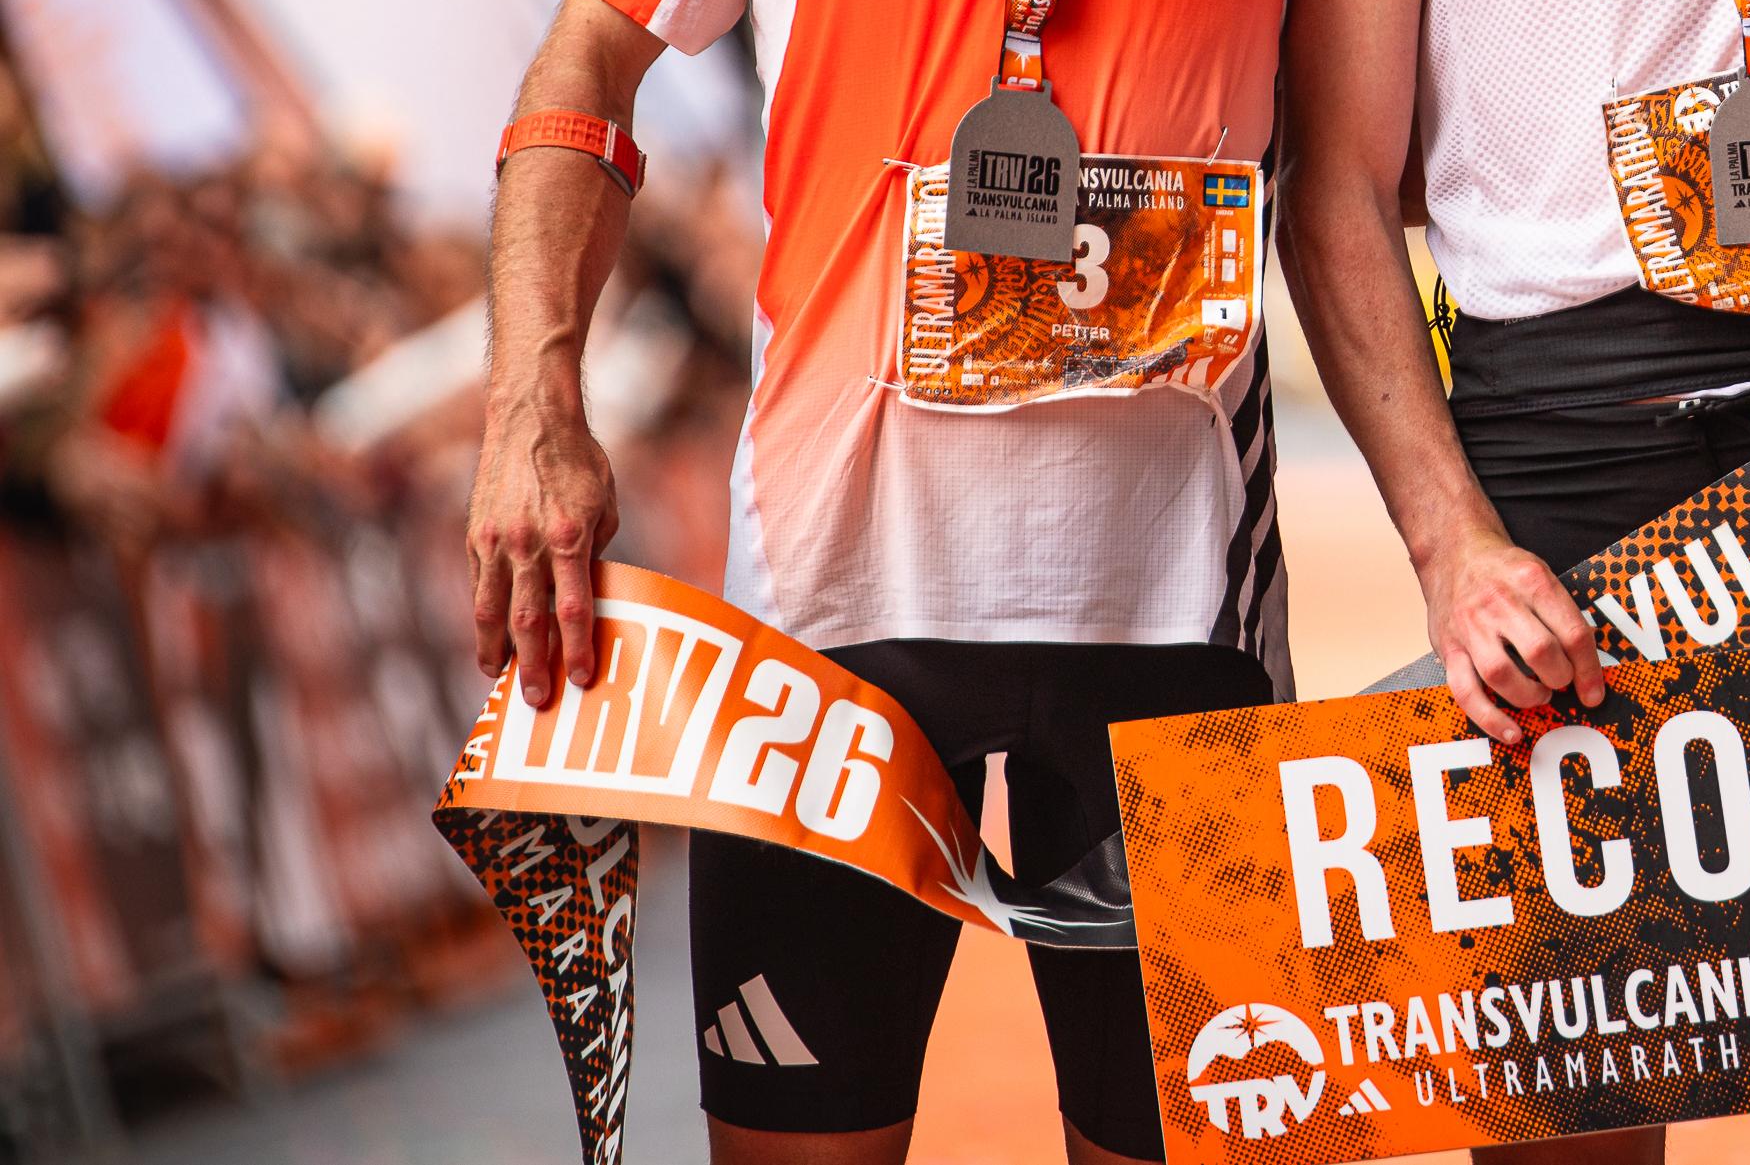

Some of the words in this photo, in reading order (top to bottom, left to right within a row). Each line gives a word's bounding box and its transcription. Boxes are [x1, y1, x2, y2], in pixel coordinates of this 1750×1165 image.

[968, 149, 980, 175] PALMA
[1727, 141, 1739, 170] PALMA
[981, 152, 1025, 191] TRV
[1027, 156, 1062, 197] 26
[966, 190, 1059, 213] TRANSVULCANIA
[1088, 193, 1131, 209] PALMA
[1138, 194, 1184, 210] ISLAND
[1609, 101, 1700, 304] ULTRAMARATHON
[979, 209, 990, 218] LA
[994, 210, 1022, 221] PALMA
[1026, 213, 1058, 225] ISLAND
[909, 166, 957, 375] ULTRAMARATHON
[1057, 223, 1111, 310] 3
[1219, 307, 1228, 320] 1
[1052, 323, 1110, 342] PETTER
[707, 657, 895, 843] 26
[1192, 1070, 1327, 1142] TRV
